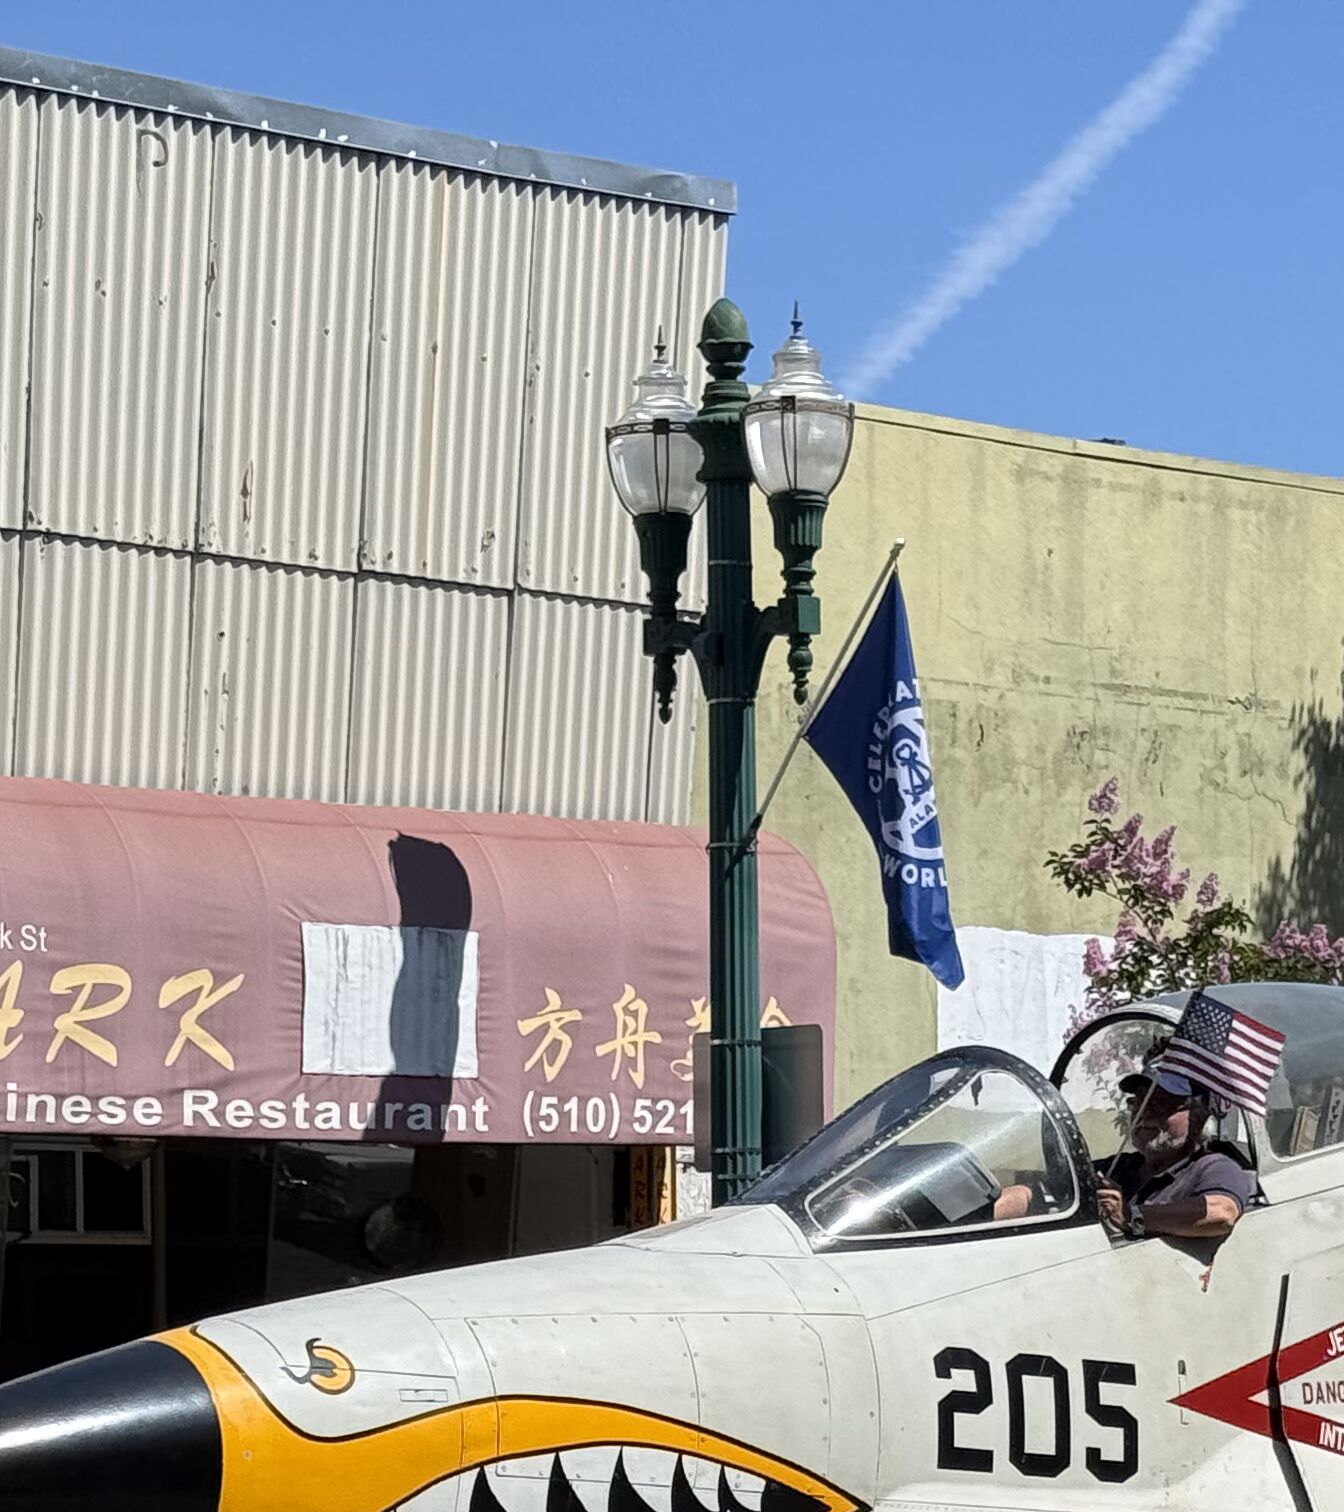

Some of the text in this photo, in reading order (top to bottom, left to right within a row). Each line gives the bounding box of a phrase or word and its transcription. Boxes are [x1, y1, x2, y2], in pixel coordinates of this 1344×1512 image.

[20, 924, 48, 952] St
[182, 1089, 489, 1133] Restaurant
[523, 1090, 620, 1139] (510)
[933, 1347, 1138, 1483] 205
